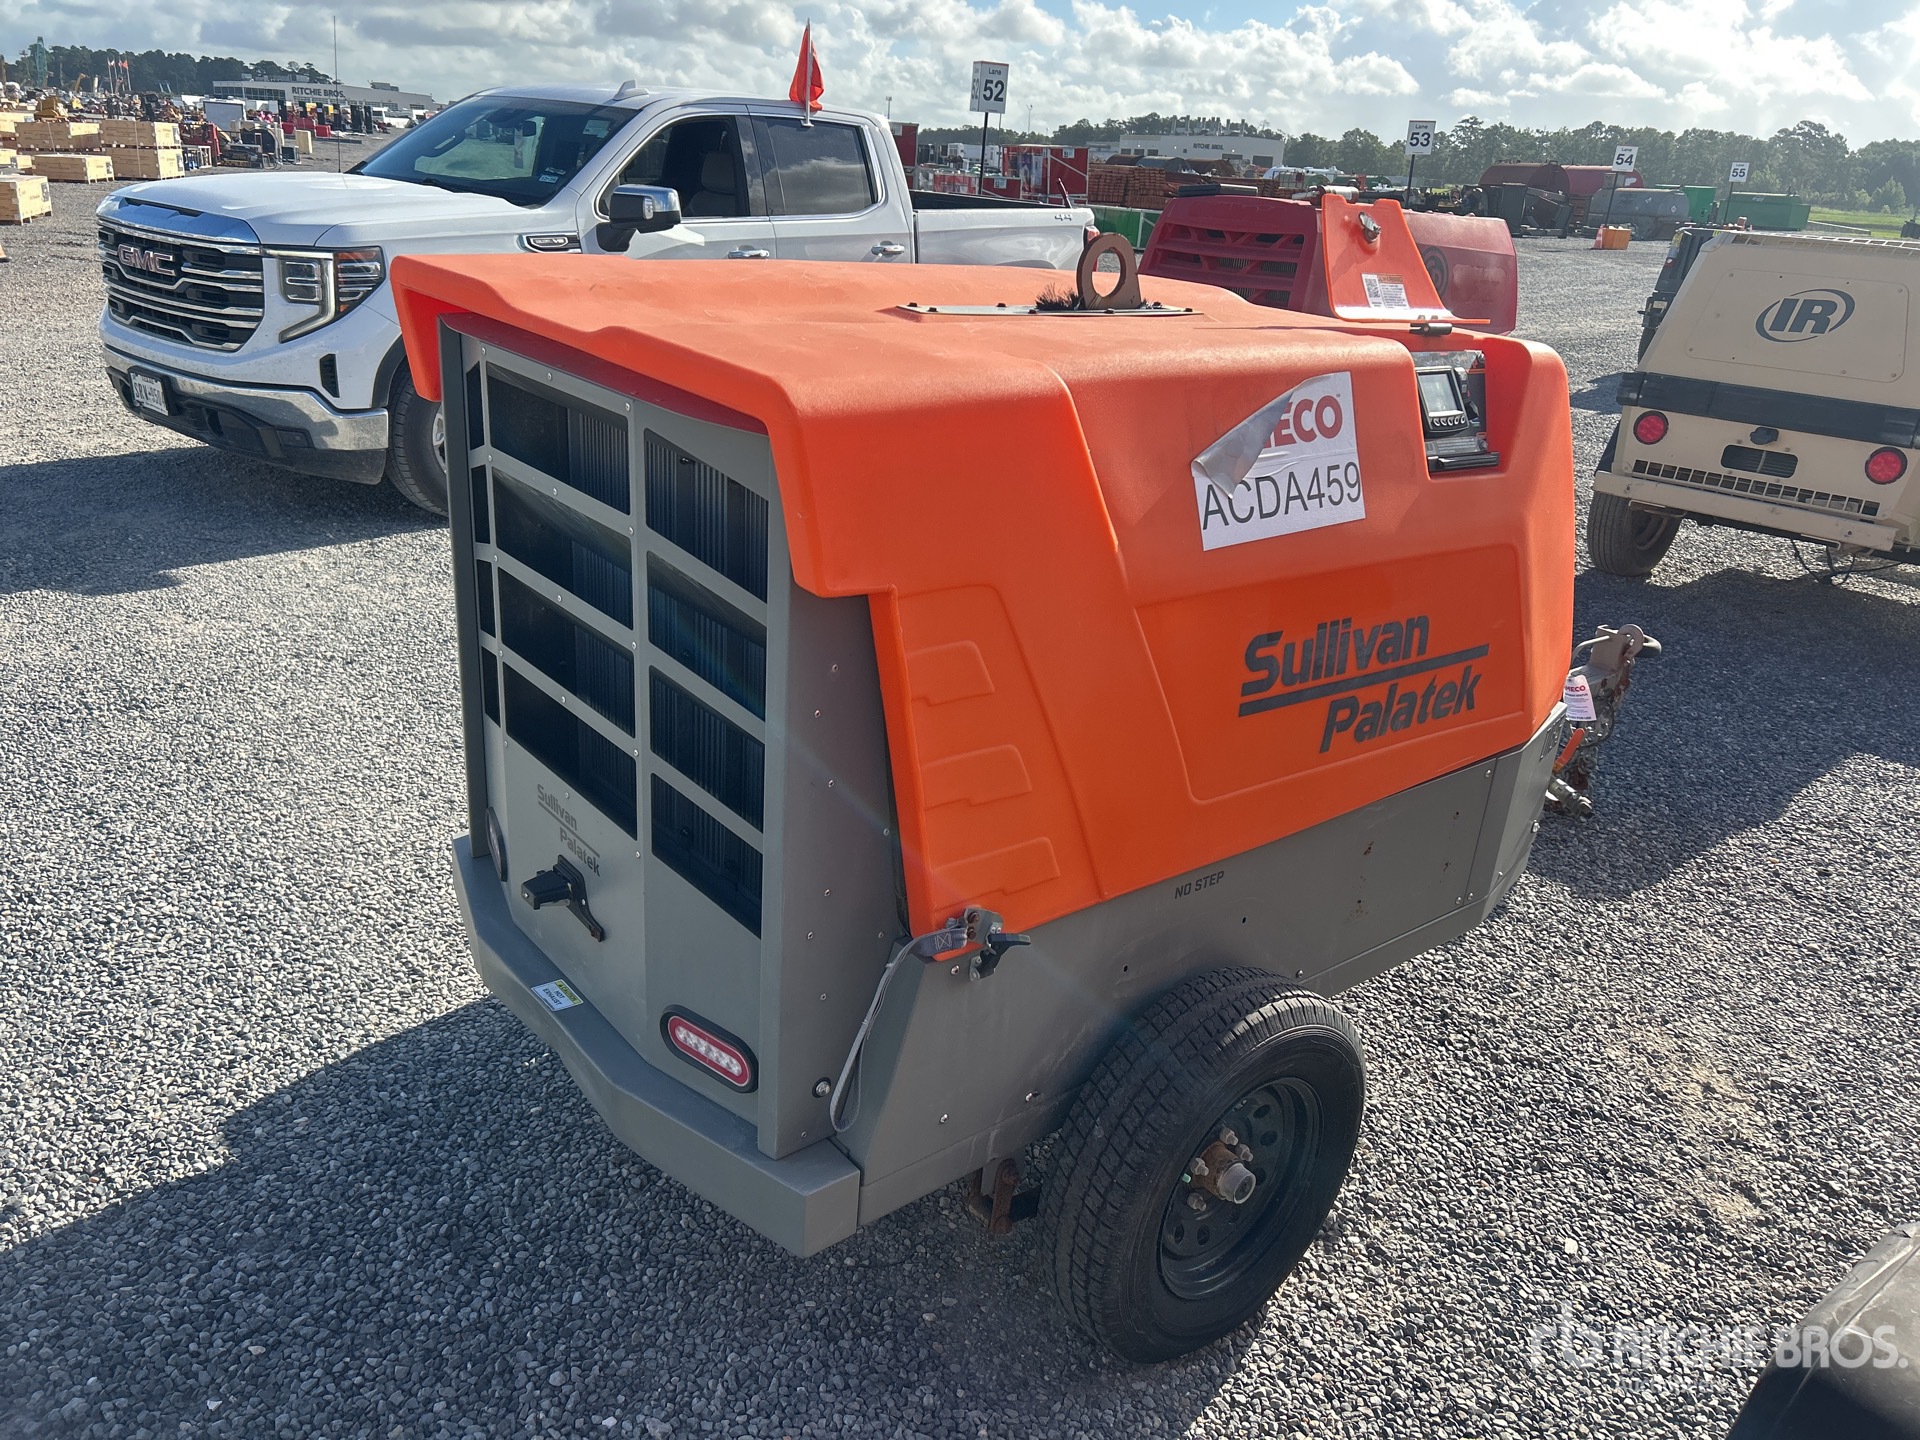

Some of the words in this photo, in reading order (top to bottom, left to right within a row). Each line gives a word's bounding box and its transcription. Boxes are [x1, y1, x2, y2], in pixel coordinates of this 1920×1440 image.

[988, 67, 1002, 76] Lane
[291, 86, 322, 96] RITCHIE
[323, 89, 346, 98] BROS.
[983, 79, 1005, 102] 52
[1409, 131, 1431, 147] 53
[1615, 153, 1634, 166] 54
[1731, 168, 1746, 178] 55
[117, 243, 176, 276] GMC
[1768, 297, 1838, 335] IR
[1263, 394, 1343, 450] ECO
[1202, 461, 1362, 531] ACDA459
[1240, 615, 1430, 698] Sullivan
[1318, 664, 1483, 754] Palatek
[537, 783, 578, 831] Sullivan
[559, 826, 601, 877] Palatek
[1174, 882, 1192, 899] NO
[1194, 870, 1225, 892] STEP
